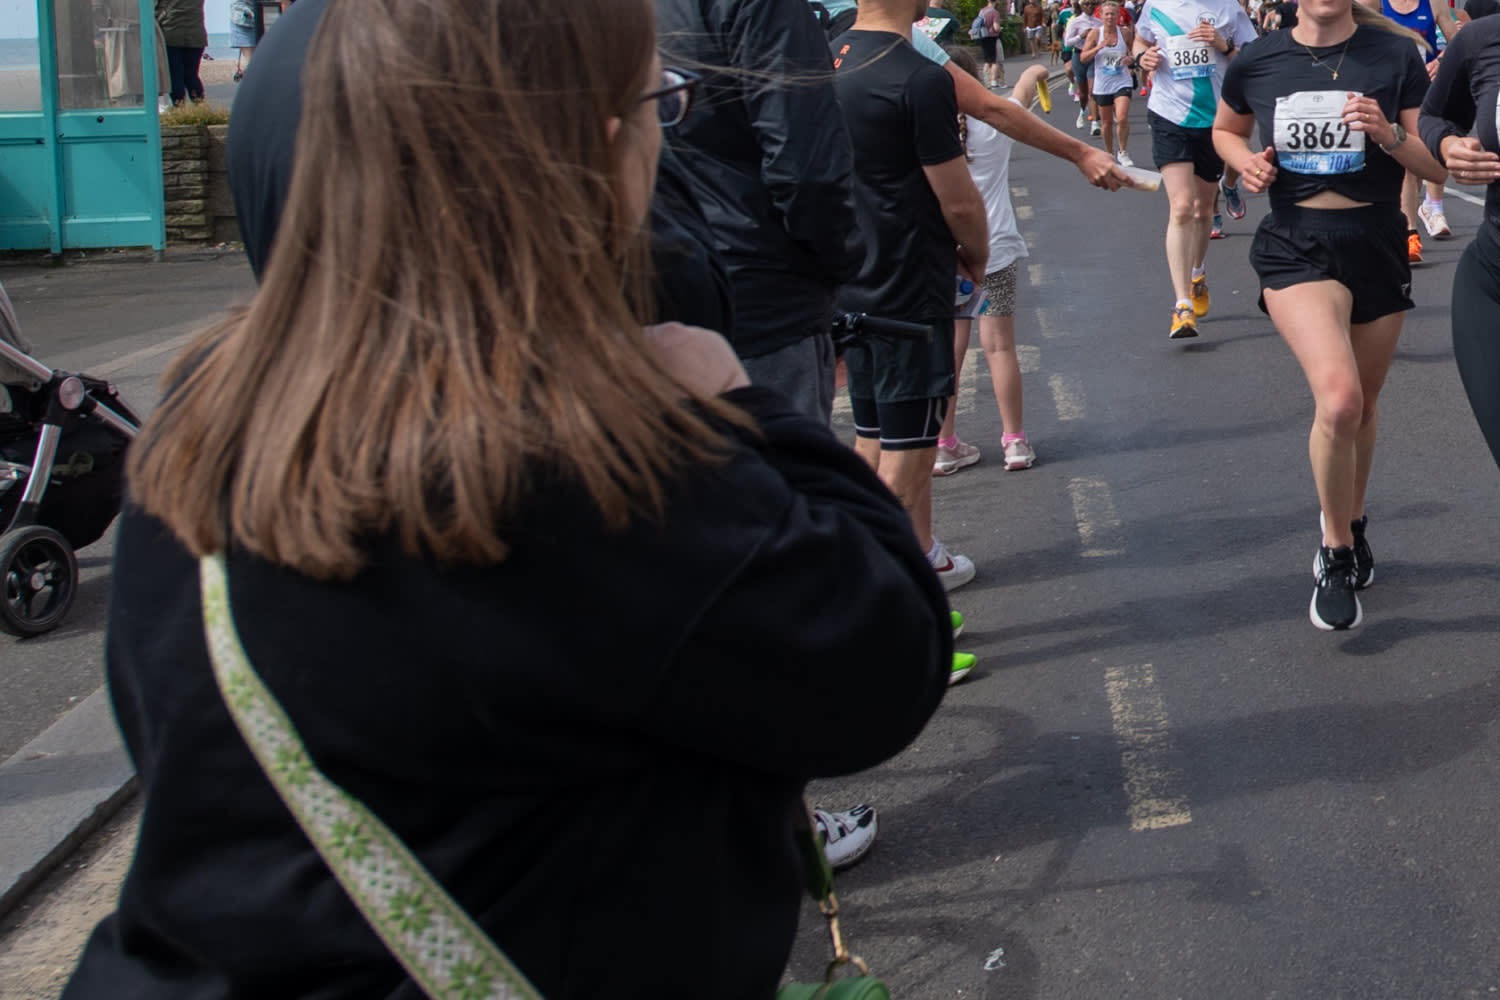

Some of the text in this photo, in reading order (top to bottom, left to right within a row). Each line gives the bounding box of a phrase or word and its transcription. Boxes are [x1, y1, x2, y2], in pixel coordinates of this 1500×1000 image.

[1174, 48, 1209, 66] 3868
[1286, 122, 1352, 150] 3862
[1329, 154, 1353, 171] 10K
